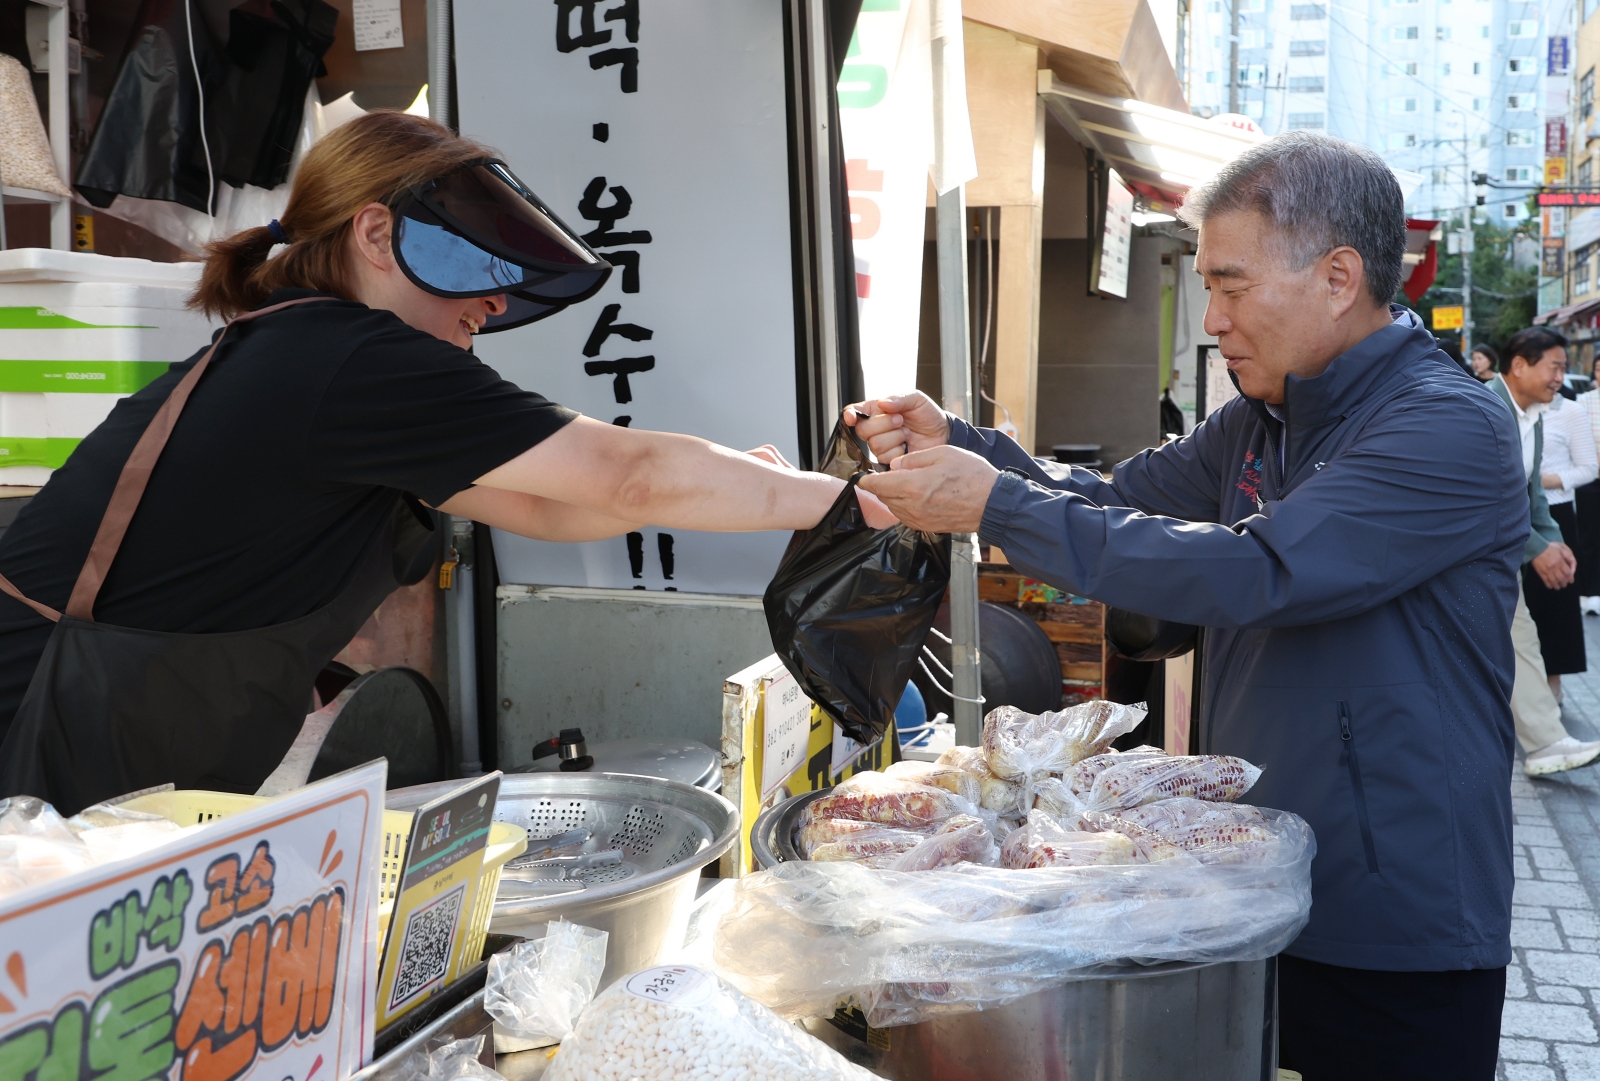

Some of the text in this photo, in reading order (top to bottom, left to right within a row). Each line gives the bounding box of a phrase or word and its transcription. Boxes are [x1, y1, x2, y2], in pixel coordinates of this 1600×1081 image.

[89, 839, 276, 981] 바삭 고소
[175, 886, 346, 1081] 센베
